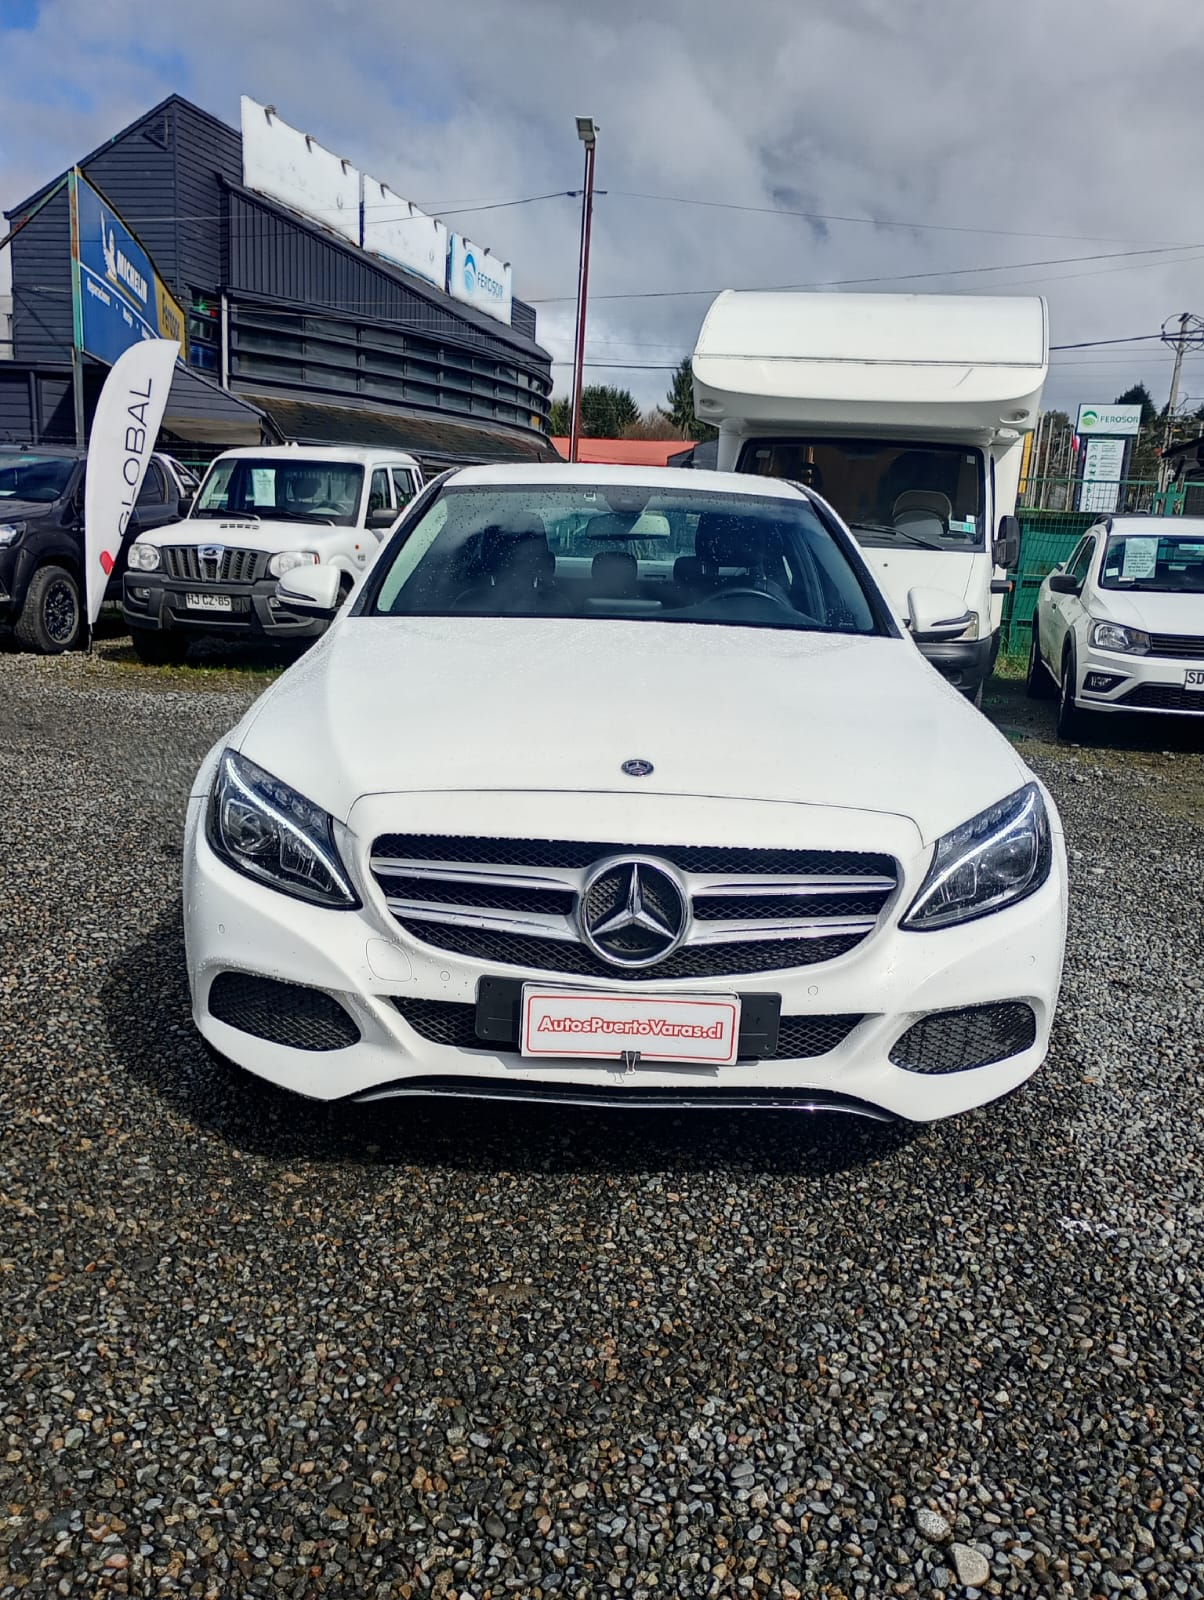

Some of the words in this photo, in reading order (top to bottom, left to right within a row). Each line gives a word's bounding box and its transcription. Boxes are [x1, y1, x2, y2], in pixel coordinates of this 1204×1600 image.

[116, 250, 148, 305] MICHELIN
[1100, 415, 1139, 424] FEROSOR
[118, 377, 152, 537] GLOBAL
[537, 1015, 724, 1041] AutosPuertoVaras.cl
